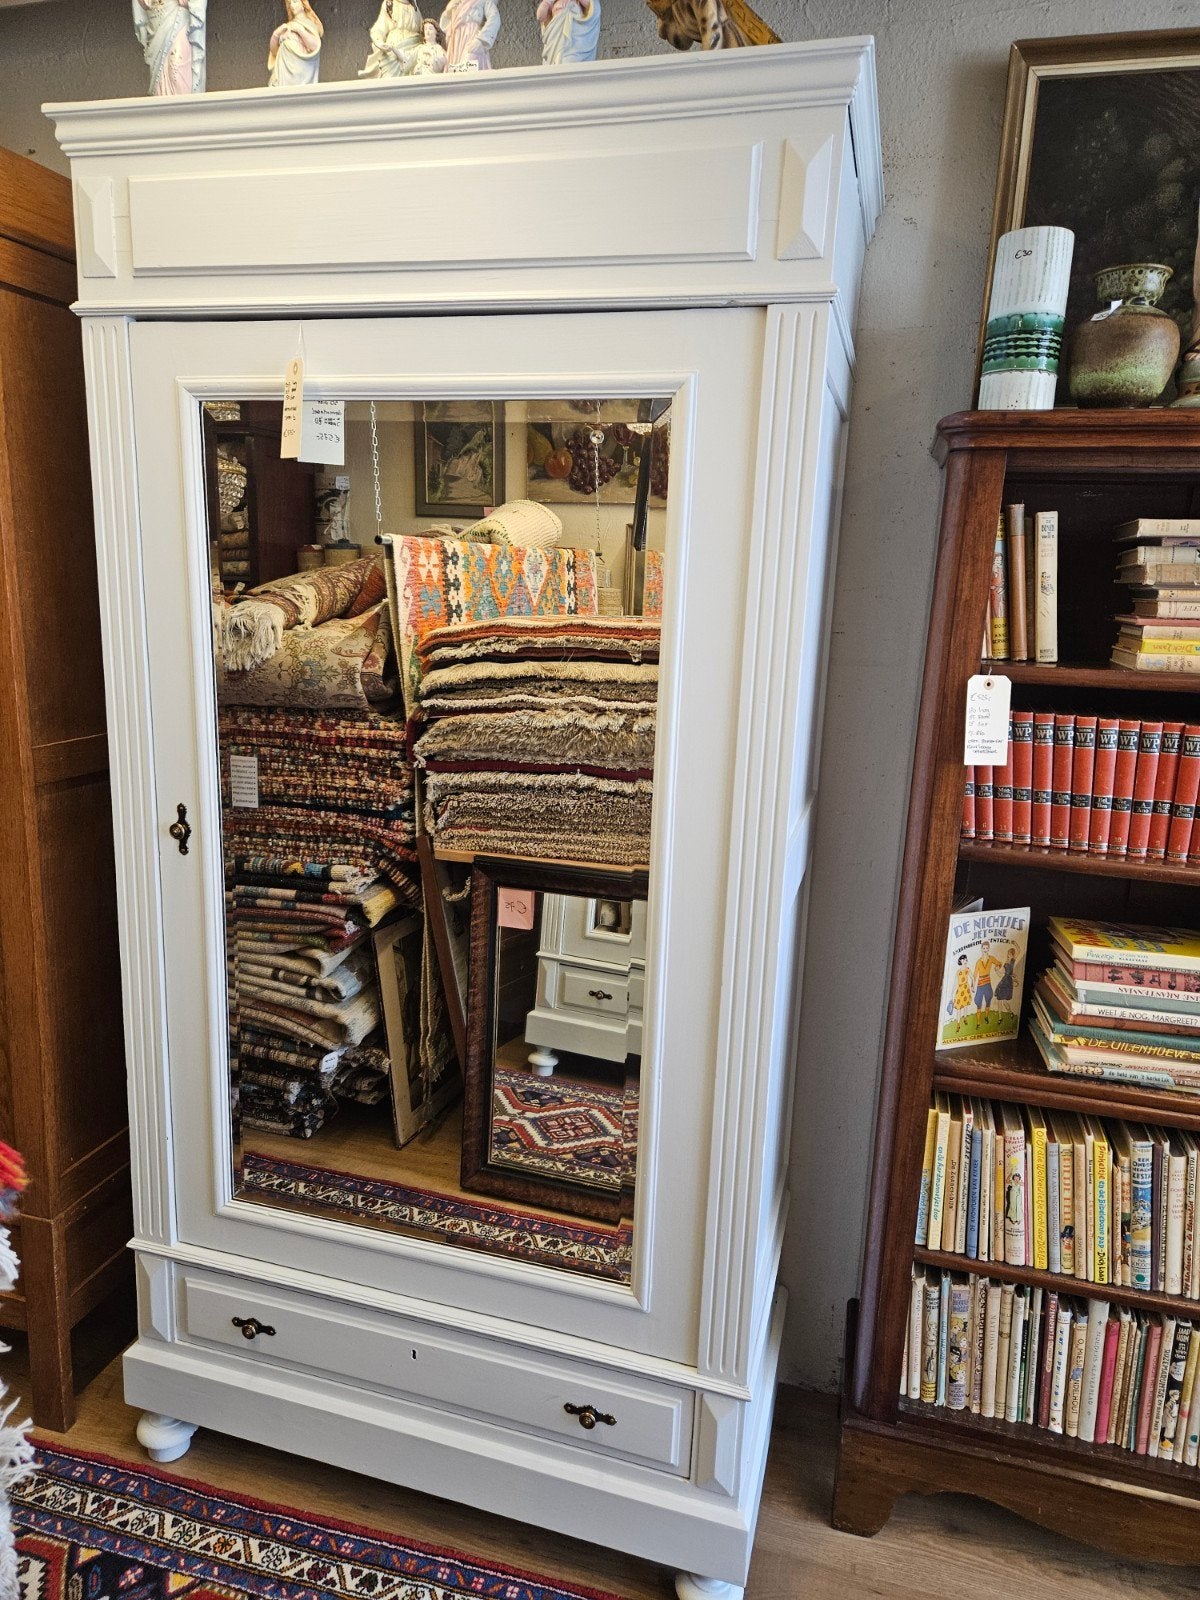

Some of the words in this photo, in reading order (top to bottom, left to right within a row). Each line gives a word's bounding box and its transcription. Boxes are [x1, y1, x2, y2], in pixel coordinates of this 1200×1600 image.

[1014, 249, 1033, 259] €30
[1015, 725, 1032, 737] WP
[1037, 727, 1053, 738] WP
[1058, 728, 1074, 740] WP
[1077, 730, 1093, 743] WP
[1100, 733, 1117, 744] WP
[1120, 735, 1137, 747] WP
[1142, 737, 1159, 749] WP
[1186, 741, 1200, 752] WP
[953, 921, 971, 938] DE
[974, 916, 1025, 930] NICHTJES
[972, 929, 987, 940] JET
[1098, 1008, 1117, 1016] WEET
[1152, 1014, 1198, 1025] MARGREET?
[1088, 1039, 1107, 1048] DE
[1110, 1041, 1190, 1058] UILENHOEVE
[1096, 1145, 1106, 1180] Pinkeltje
[1097, 1180, 1105, 1188] en
[1098, 1188, 1105, 1198] de
[1096, 1250, 1106, 1264] Dick
